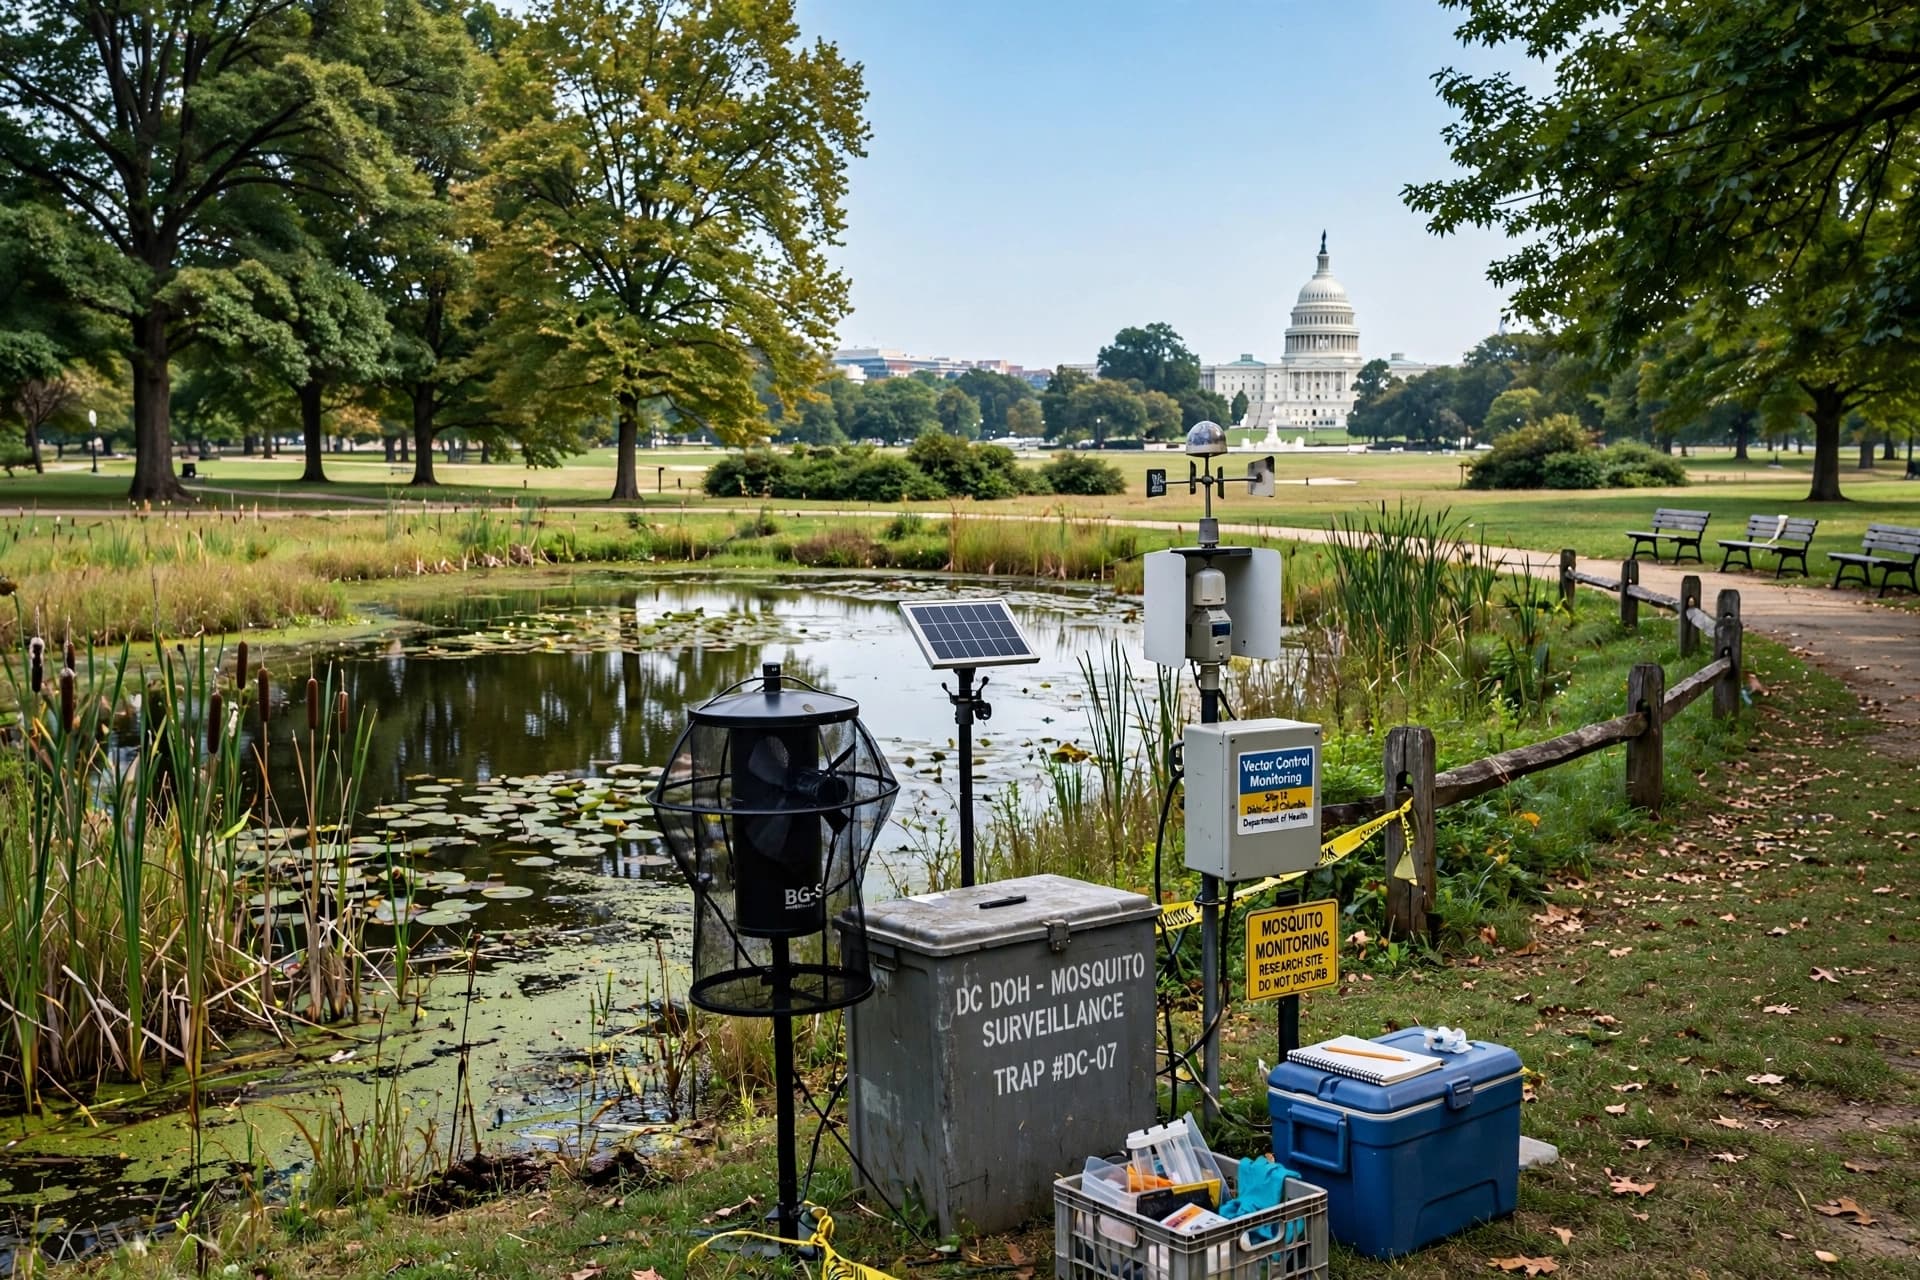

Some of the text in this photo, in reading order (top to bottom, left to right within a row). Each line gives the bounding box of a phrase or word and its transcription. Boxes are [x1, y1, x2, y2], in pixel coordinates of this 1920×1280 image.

[1242, 753, 1310, 772] Vector Control
[1250, 771, 1302, 788] Monitoring
[1243, 812, 1308, 830] Department of Health
[785, 883, 823, 905] BG-S
[1262, 912, 1323, 937] MOSQUITO
[1256, 931, 1329, 960] MONITORING
[1259, 958, 1303, 976] RESEARCH
[1305, 953, 1323, 967] SITE
[956, 985, 983, 1016] DC
[990, 975, 1030, 1009] DOH
[1051, 952, 1145, 996] MOSQUITO
[1258, 968, 1328, 992] DO NOT DISTURB
[982, 992, 1124, 1048] SURVEILLANCE
[993, 1042, 1118, 1096] TRAP #DC-07
